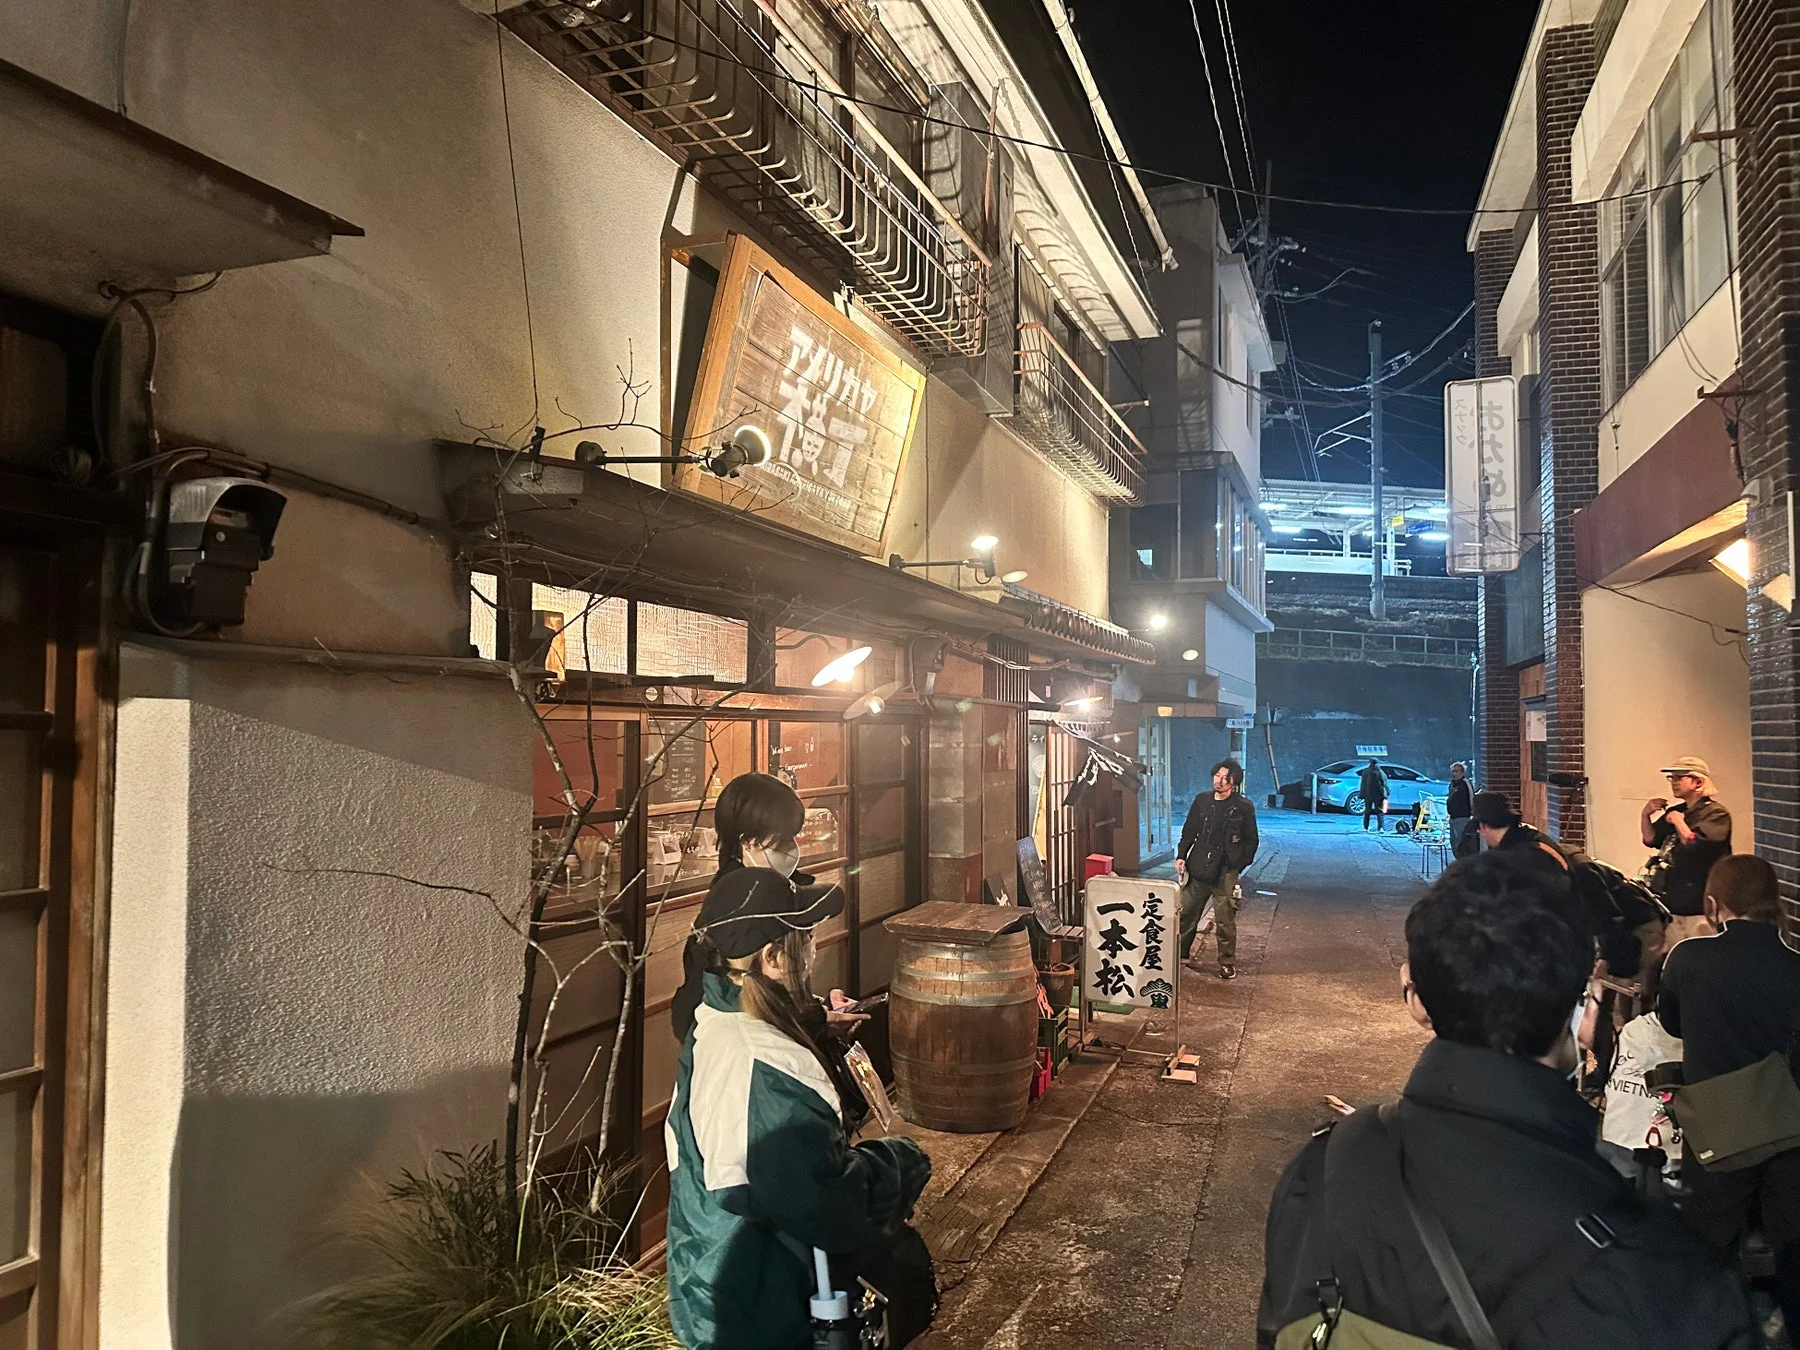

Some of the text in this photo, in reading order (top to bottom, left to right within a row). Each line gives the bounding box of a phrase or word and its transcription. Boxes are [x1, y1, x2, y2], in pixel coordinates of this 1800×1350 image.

[783, 325, 878, 422] アメリカヤ
[1092, 901, 1139, 998] 一本松
[1138, 892, 1166, 972] 定食屋
